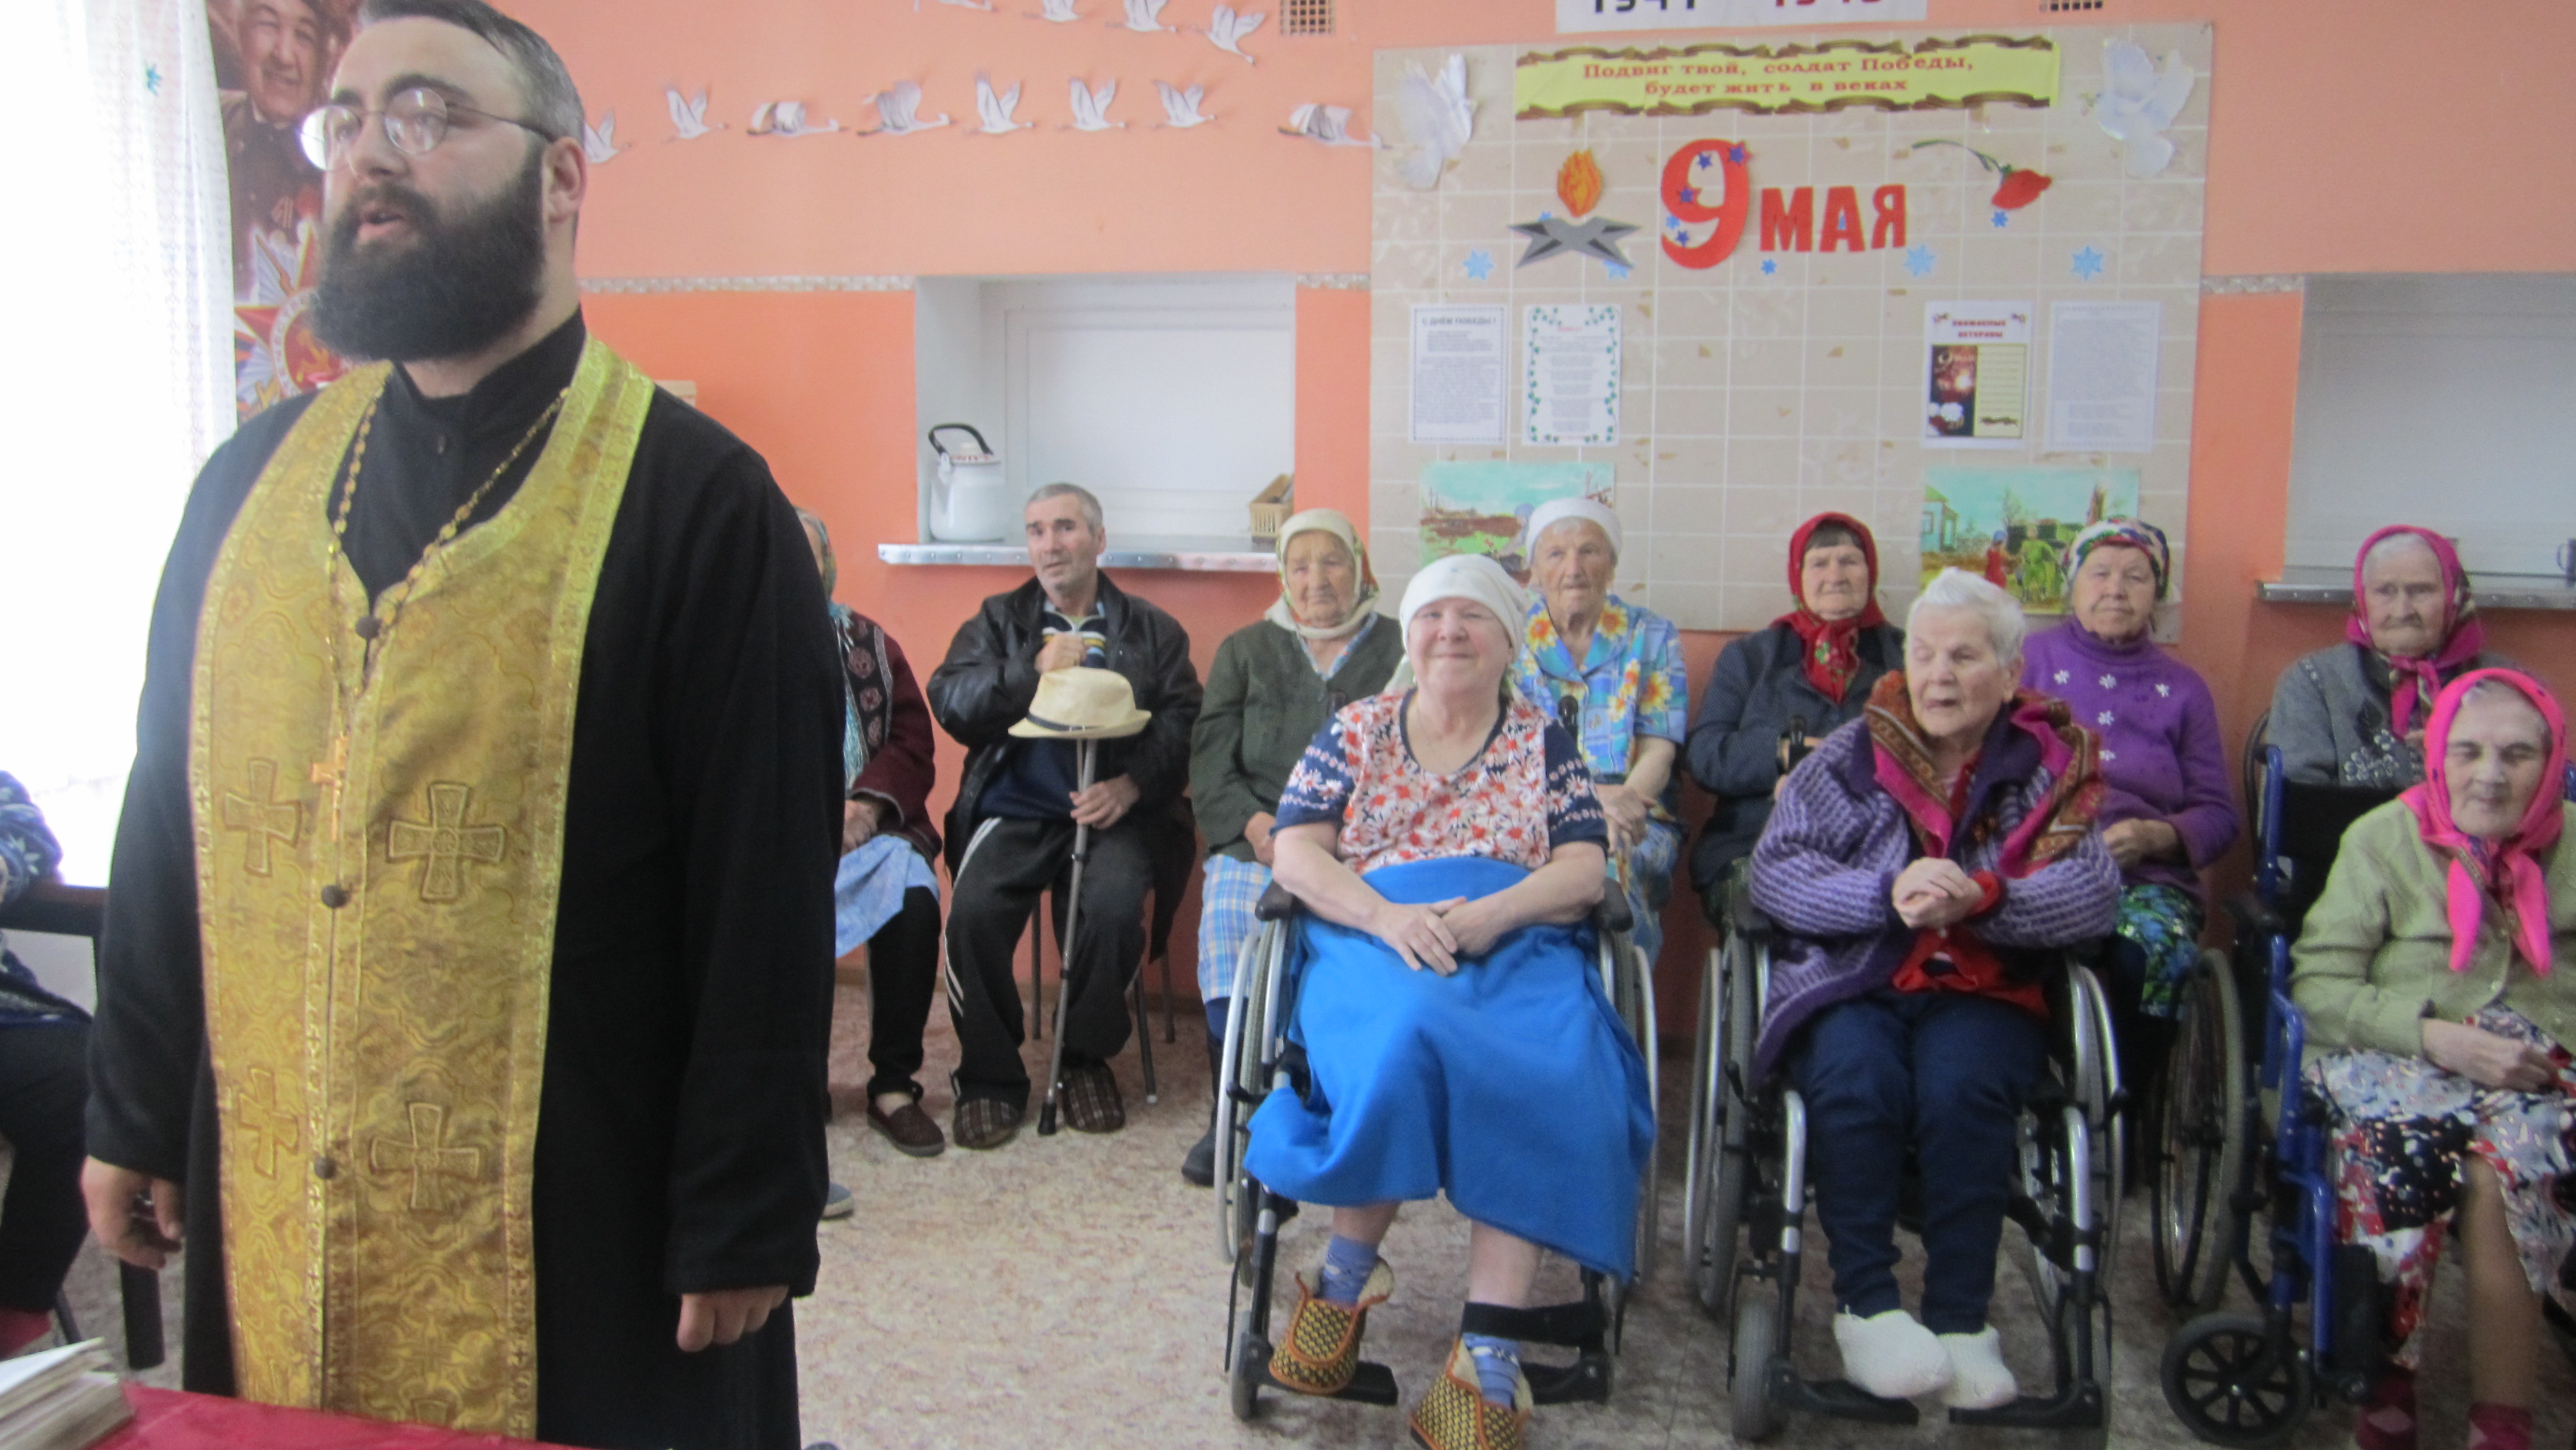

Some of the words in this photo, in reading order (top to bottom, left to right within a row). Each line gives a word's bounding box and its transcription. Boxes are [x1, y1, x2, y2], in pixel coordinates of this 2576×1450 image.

[1584, 63, 1671, 79] Подвиг
[1681, 61, 1747, 76] твой,
[1763, 61, 1851, 73] солдат
[1860, 57, 1973, 71] Победы,
[1645, 81, 1715, 98] будет
[1724, 82, 1791, 94] жить
[1810, 82, 1823, 91] в
[1833, 80, 1908, 91] веках
[1661, 138, 1751, 269] 9
[1759, 184, 1907, 253] МАЯ
